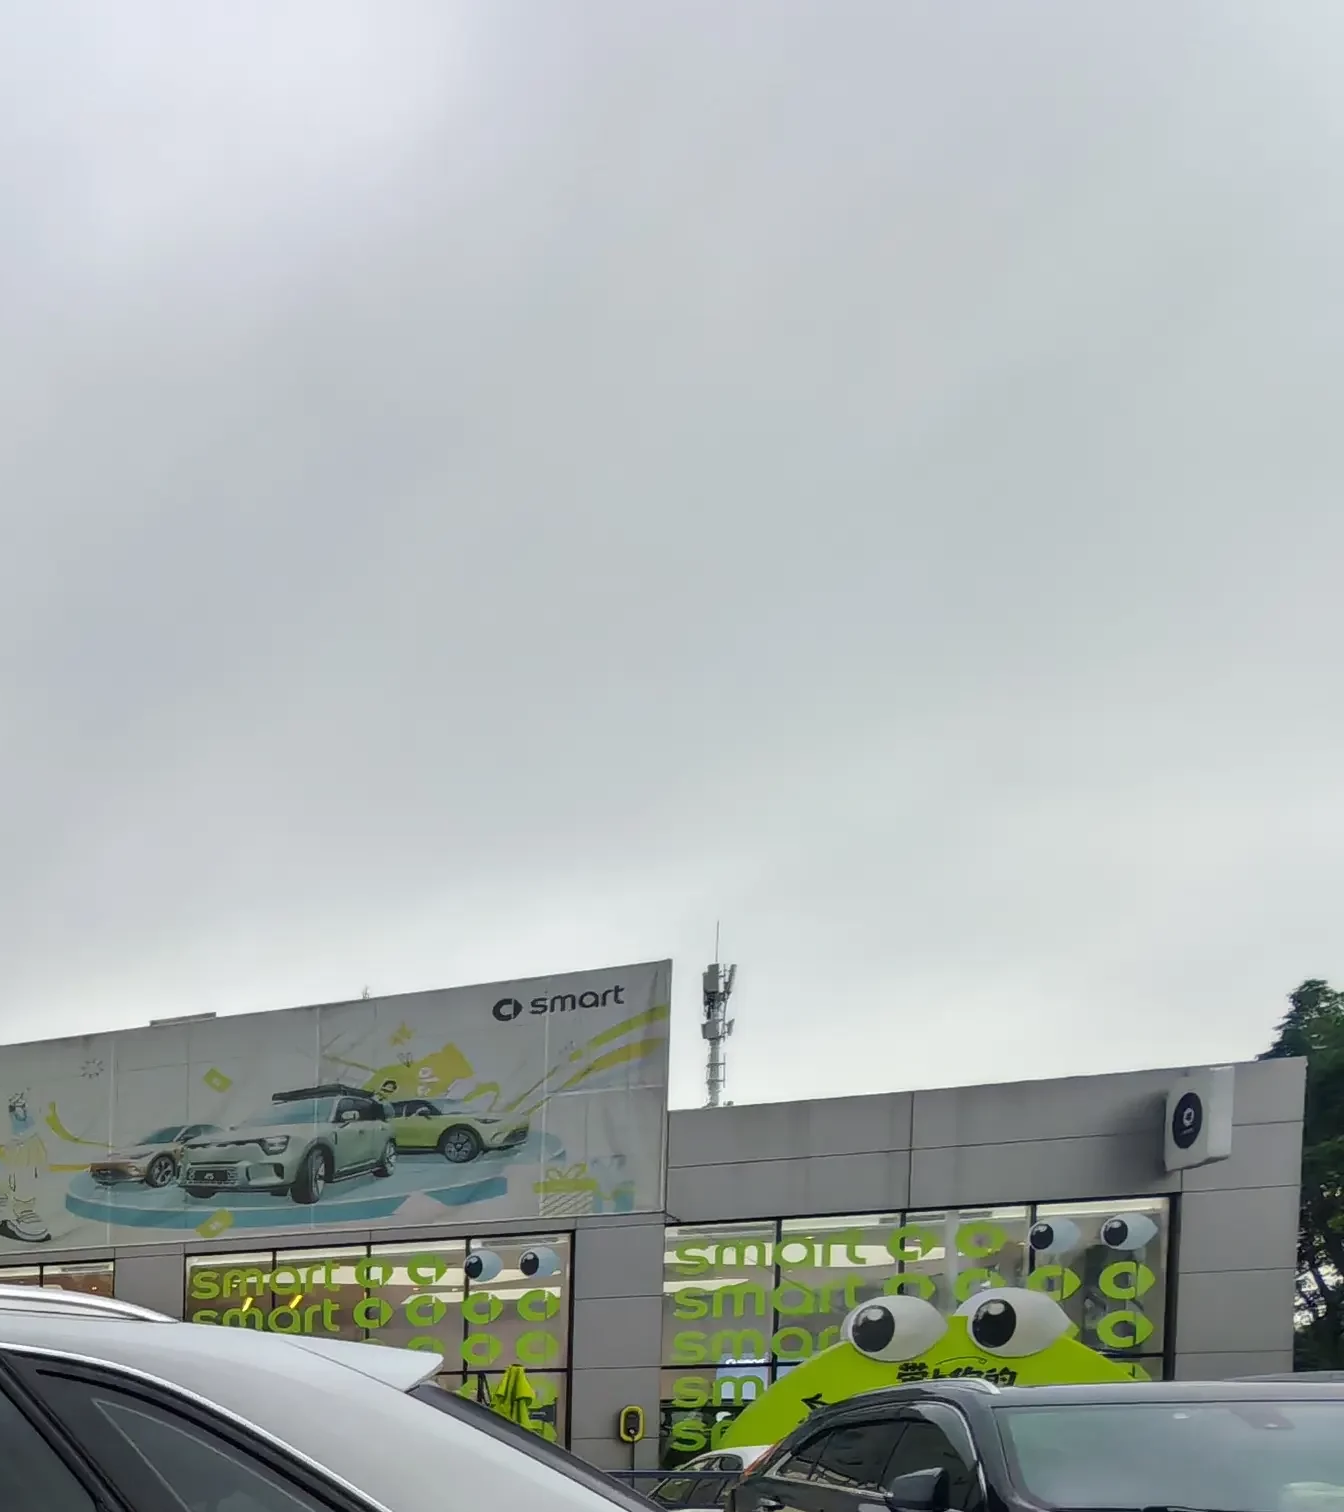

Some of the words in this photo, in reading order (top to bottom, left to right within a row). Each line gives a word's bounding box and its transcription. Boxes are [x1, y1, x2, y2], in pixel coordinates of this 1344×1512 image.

[529, 985, 625, 1015] smart
[674, 1229, 868, 1276] smart
[191, 1259, 341, 1300] smart
[673, 1273, 865, 1320] smart
[191, 1298, 341, 1335] smart
[671, 1325, 840, 1363] smar
